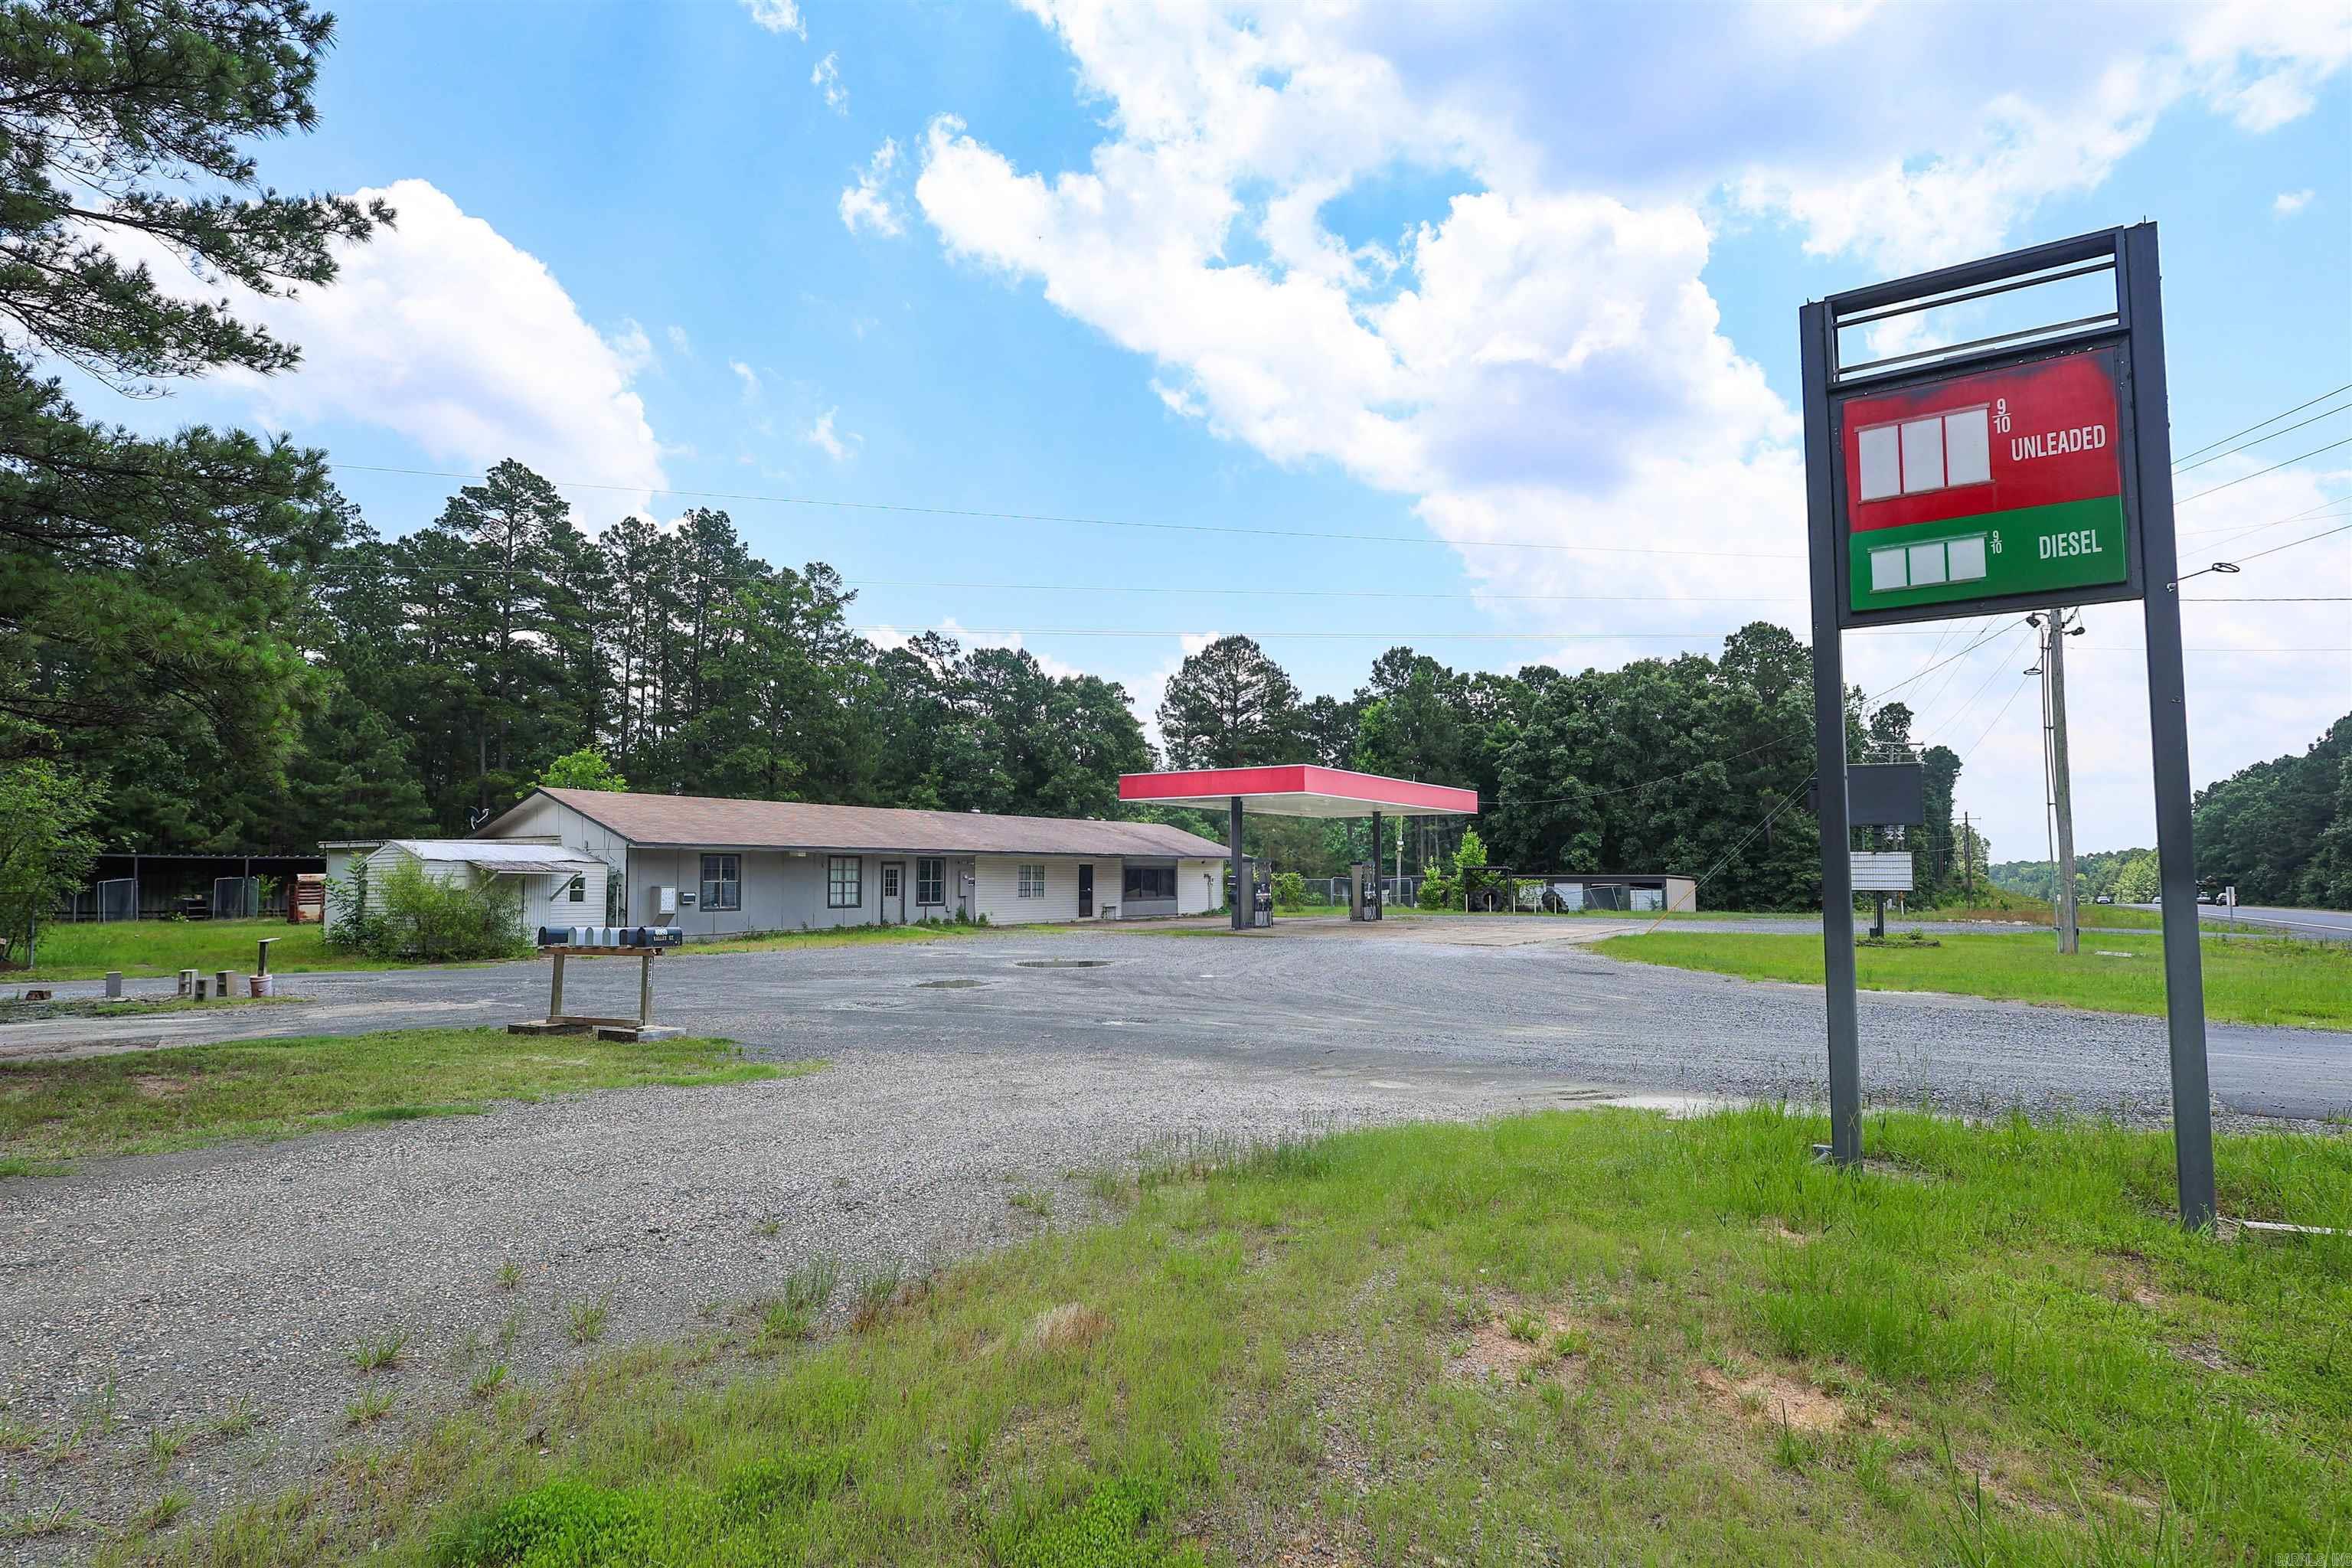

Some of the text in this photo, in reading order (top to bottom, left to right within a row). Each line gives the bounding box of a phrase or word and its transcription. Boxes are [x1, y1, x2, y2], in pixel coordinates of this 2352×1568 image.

[1997, 397, 2007, 414] 9
[1994, 416, 2011, 434] 10
[2011, 424, 2106, 462] UNLEADED
[1992, 530, 1999, 541] 9
[1991, 542, 2002, 554] 10
[2039, 529, 2102, 560] DIESEL
